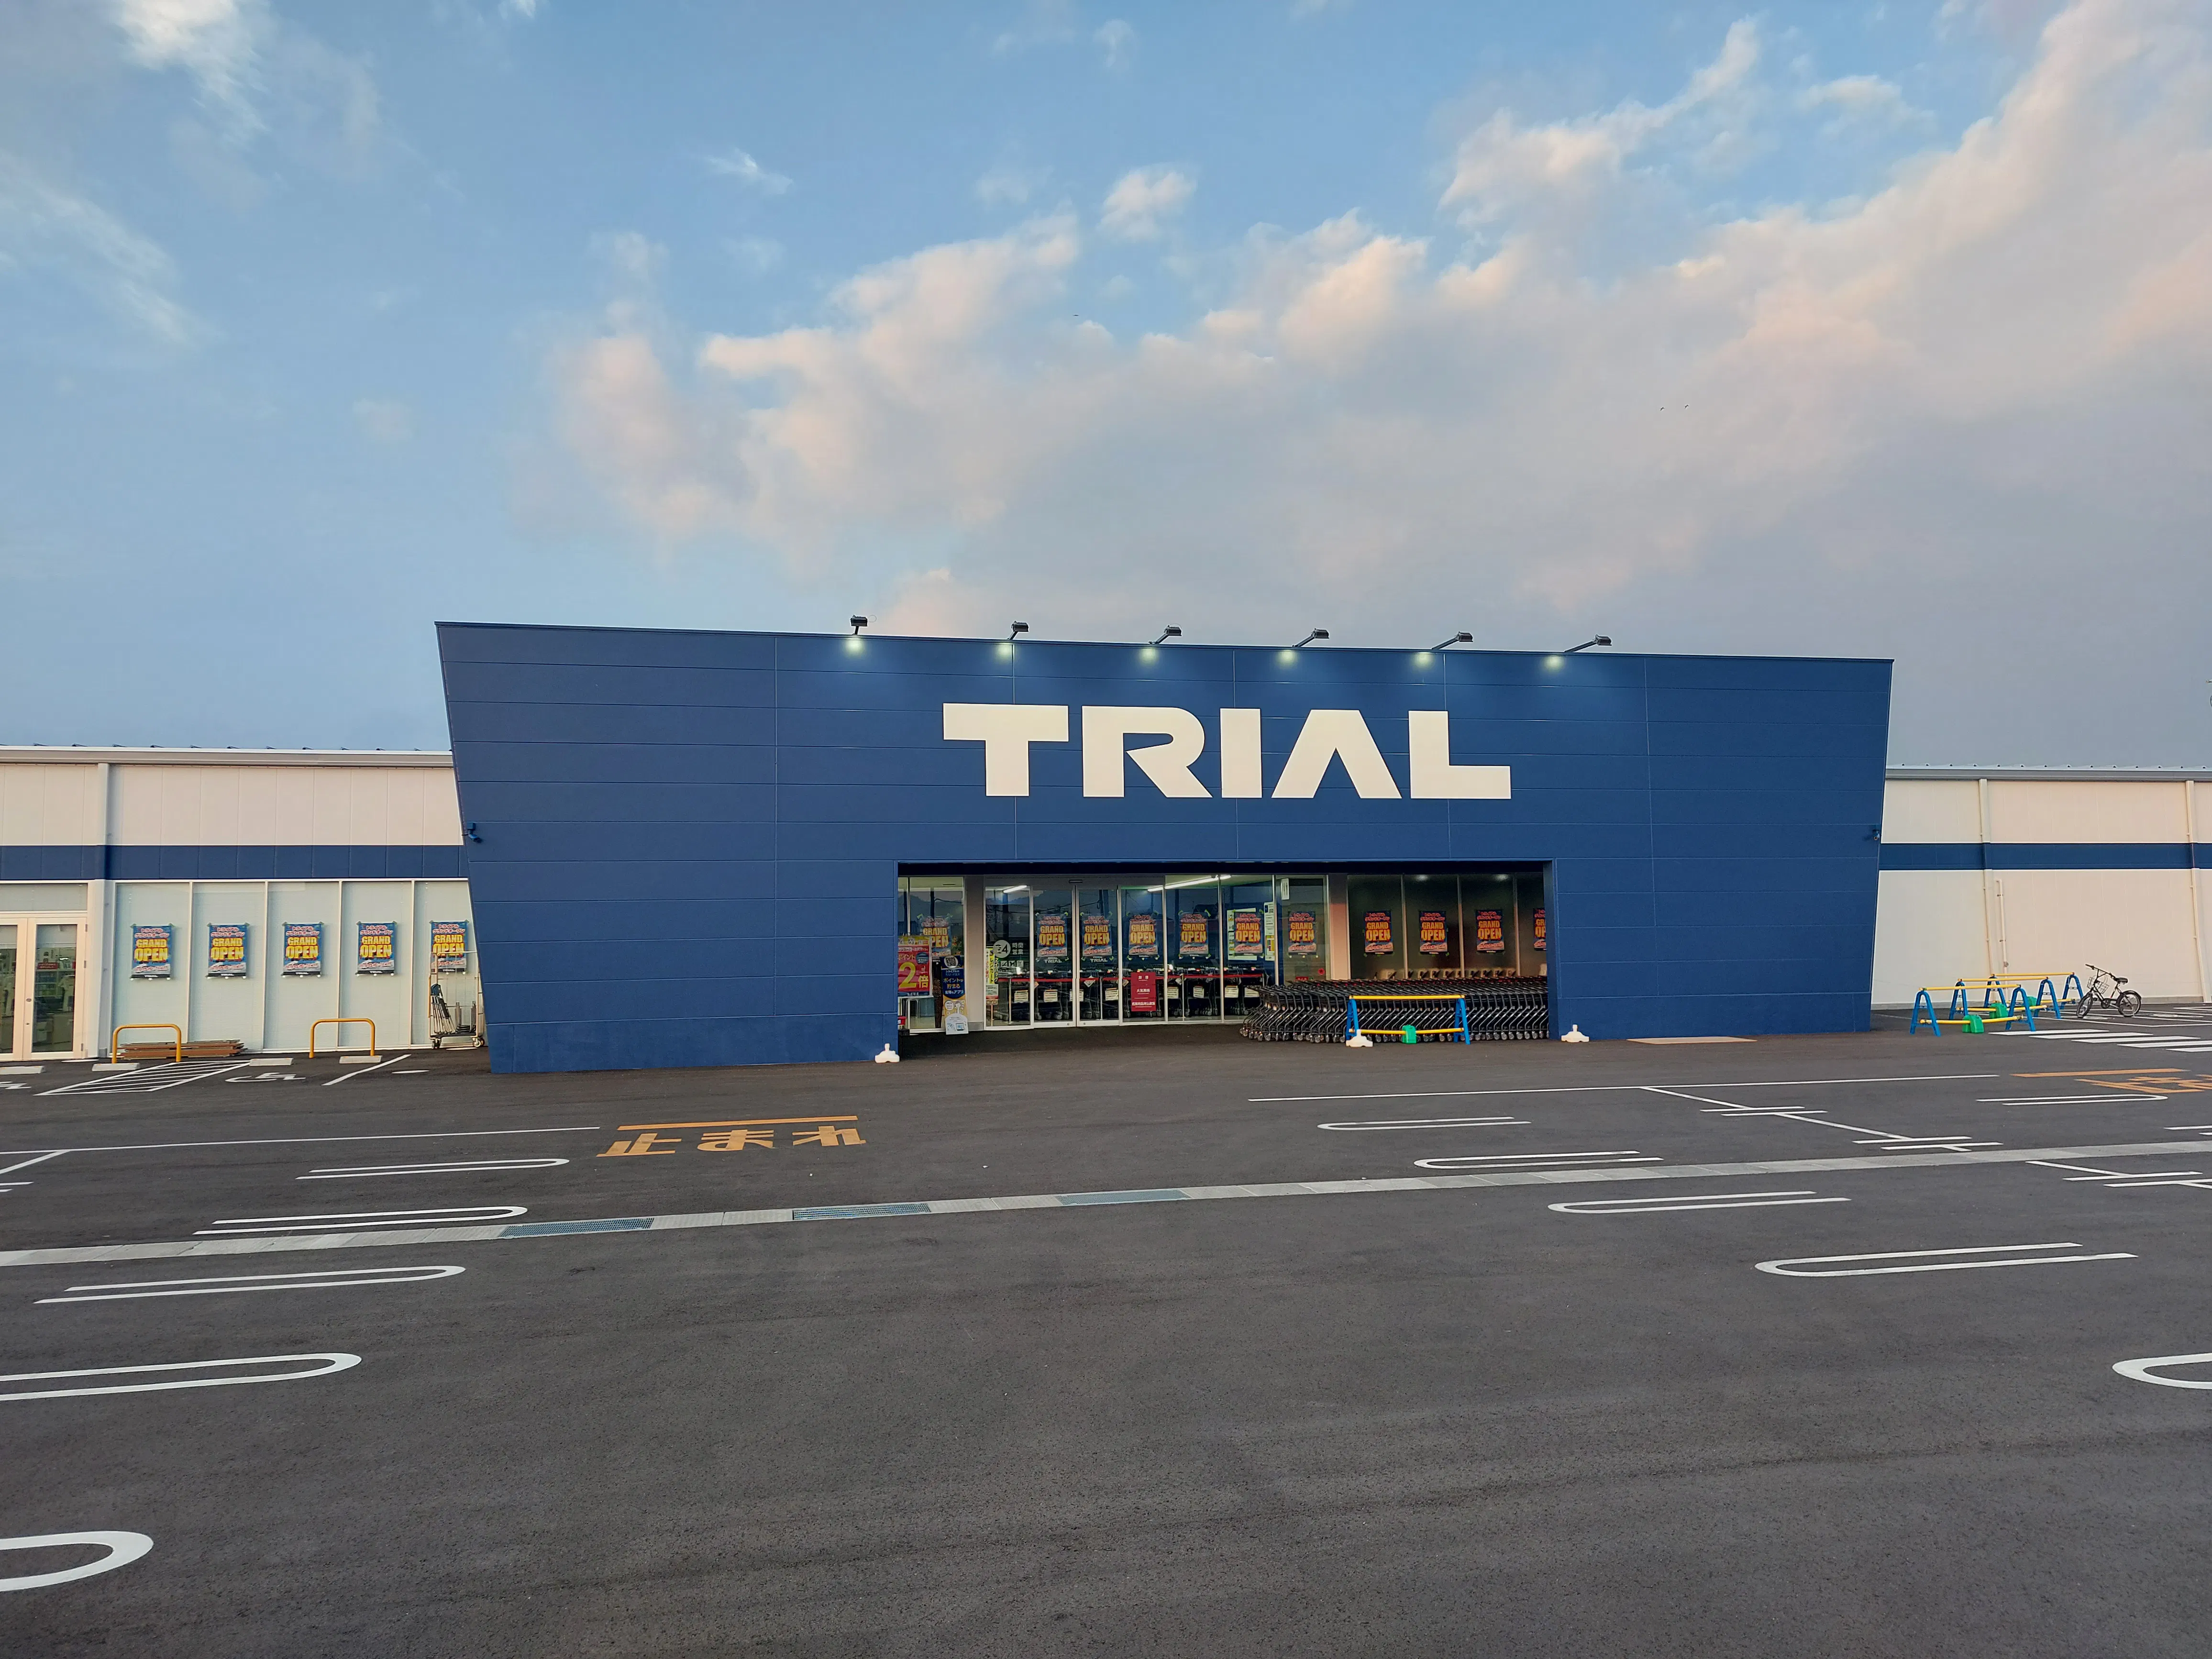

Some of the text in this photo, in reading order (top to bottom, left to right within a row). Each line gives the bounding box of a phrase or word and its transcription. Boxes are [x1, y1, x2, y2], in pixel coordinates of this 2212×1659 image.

[943, 703, 1512, 799] TRIAL
[362, 936, 391, 944] GRAND
[434, 935, 463, 943] GRAND
[1039, 933, 1065, 945] OPEN
[1084, 933, 1110, 944] OPEN
[1130, 932, 1155, 944] OPEN
[1181, 931, 1206, 942] OPEN
[1236, 930, 1261, 942] OPEN
[1290, 930, 1314, 941] OPEN
[1366, 930, 1391, 941] OPEN
[1421, 930, 1445, 941] OPEN
[1478, 929, 1502, 940] OPEN
[136, 939, 167, 948] GRAND
[212, 938, 243, 946] GRAND
[288, 937, 317, 945] GRAND
[931, 936, 949, 947] PEN
[134, 948, 168, 961] OPEN
[210, 947, 244, 960] OPEN
[286, 946, 319, 958] OPEN
[360, 945, 392, 958] OPEN
[433, 943, 465, 956] OPEN
[995, 944, 1008, 954] 24
[597, 1126, 866, 1157] 止まれ
